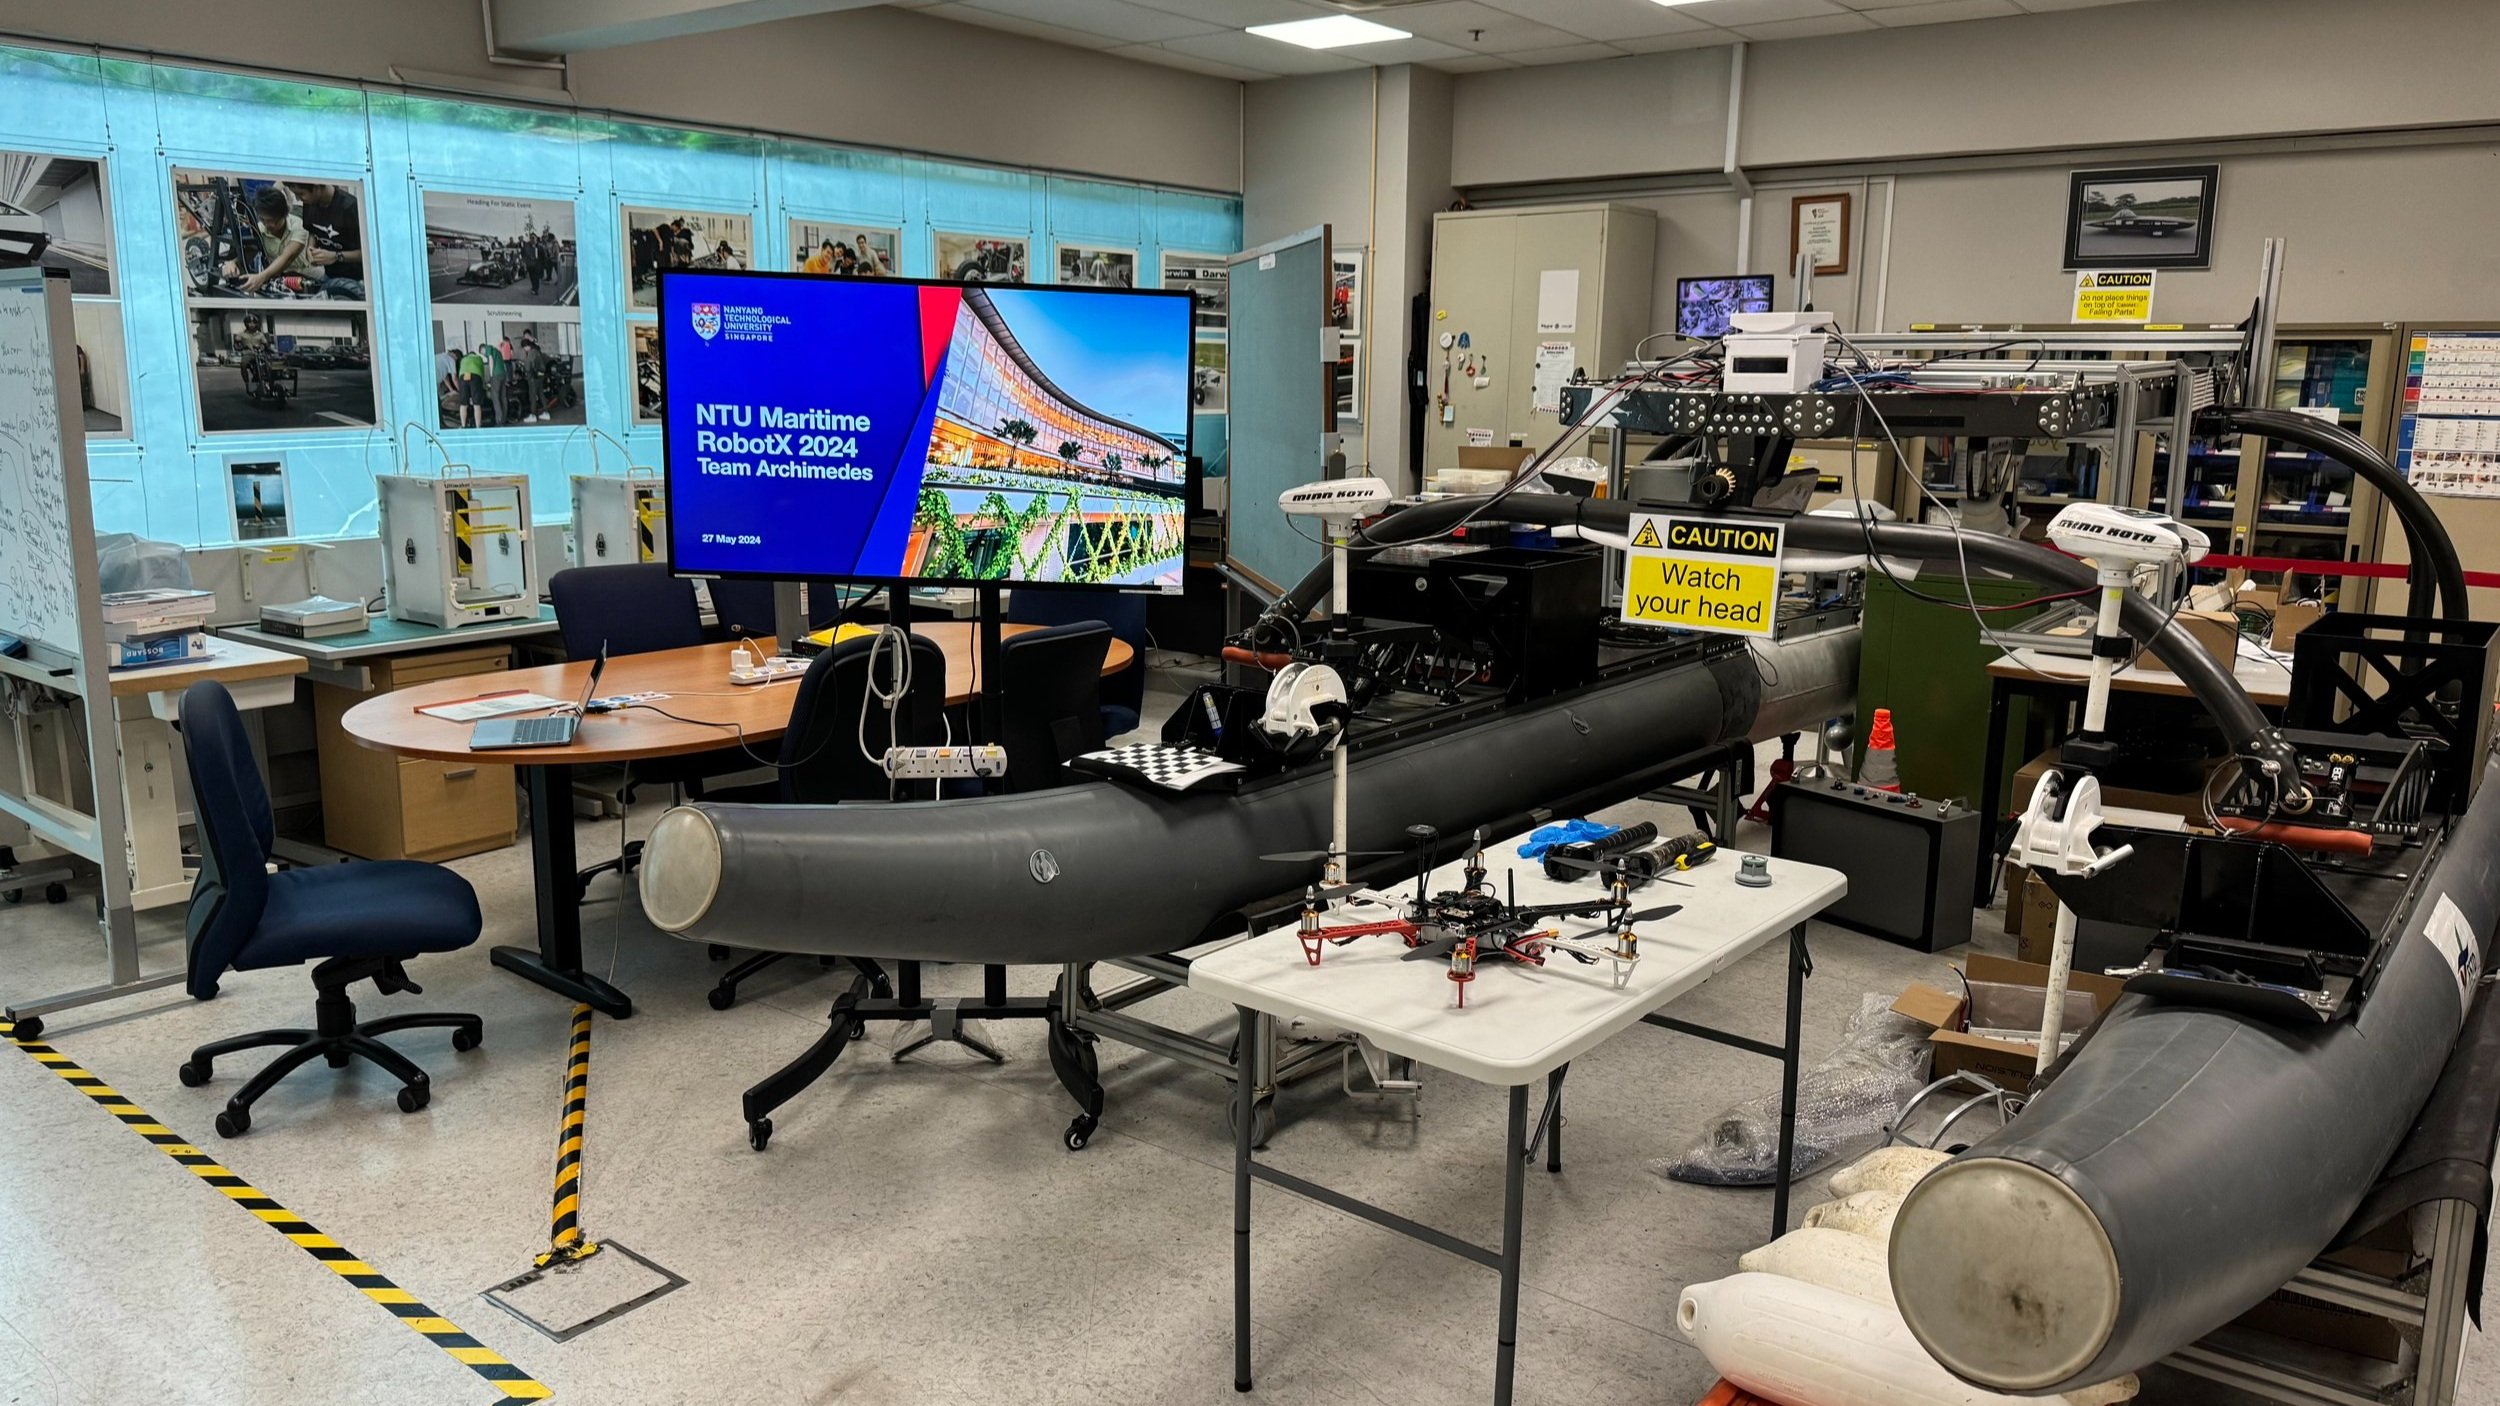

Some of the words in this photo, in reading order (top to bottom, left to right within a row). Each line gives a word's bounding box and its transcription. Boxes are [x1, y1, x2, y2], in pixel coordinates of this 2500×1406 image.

[467, 199, 490, 208] Heading
[1203, 270, 1227, 278] Darw
[2098, 274, 2150, 285] CAUTION
[2105, 294, 2124, 303] place
[2126, 294, 2148, 303] things
[723, 305, 763, 315] NANYANG
[2094, 302, 2105, 310] top
[2089, 308, 2112, 317] Falling
[2114, 308, 2135, 316] Parts!
[724, 314, 791, 325] TECHNOLOGICAL
[724, 322, 772, 332] UNIVERSITY
[725, 333, 773, 342] SINGAPORE
[696, 403, 751, 427] NTU
[759, 406, 871, 432] Maritime
[697, 430, 793, 456] RobotX
[798, 435, 858, 458] 2024
[697, 457, 752, 476] Team
[755, 459, 873, 481] Archimedes
[702, 534, 714, 543] 27
[716, 534, 737, 545] May
[738, 535, 761, 544] 2024
[1671, 525, 1775, 552] CAUTION
[2106, 527, 2157, 544] KOTA
[1662, 562, 1740, 591] Watch
[1635, 594, 1691, 616] your
[1698, 595, 1762, 623] head
[126, 647, 164, 658] BOSSARD
